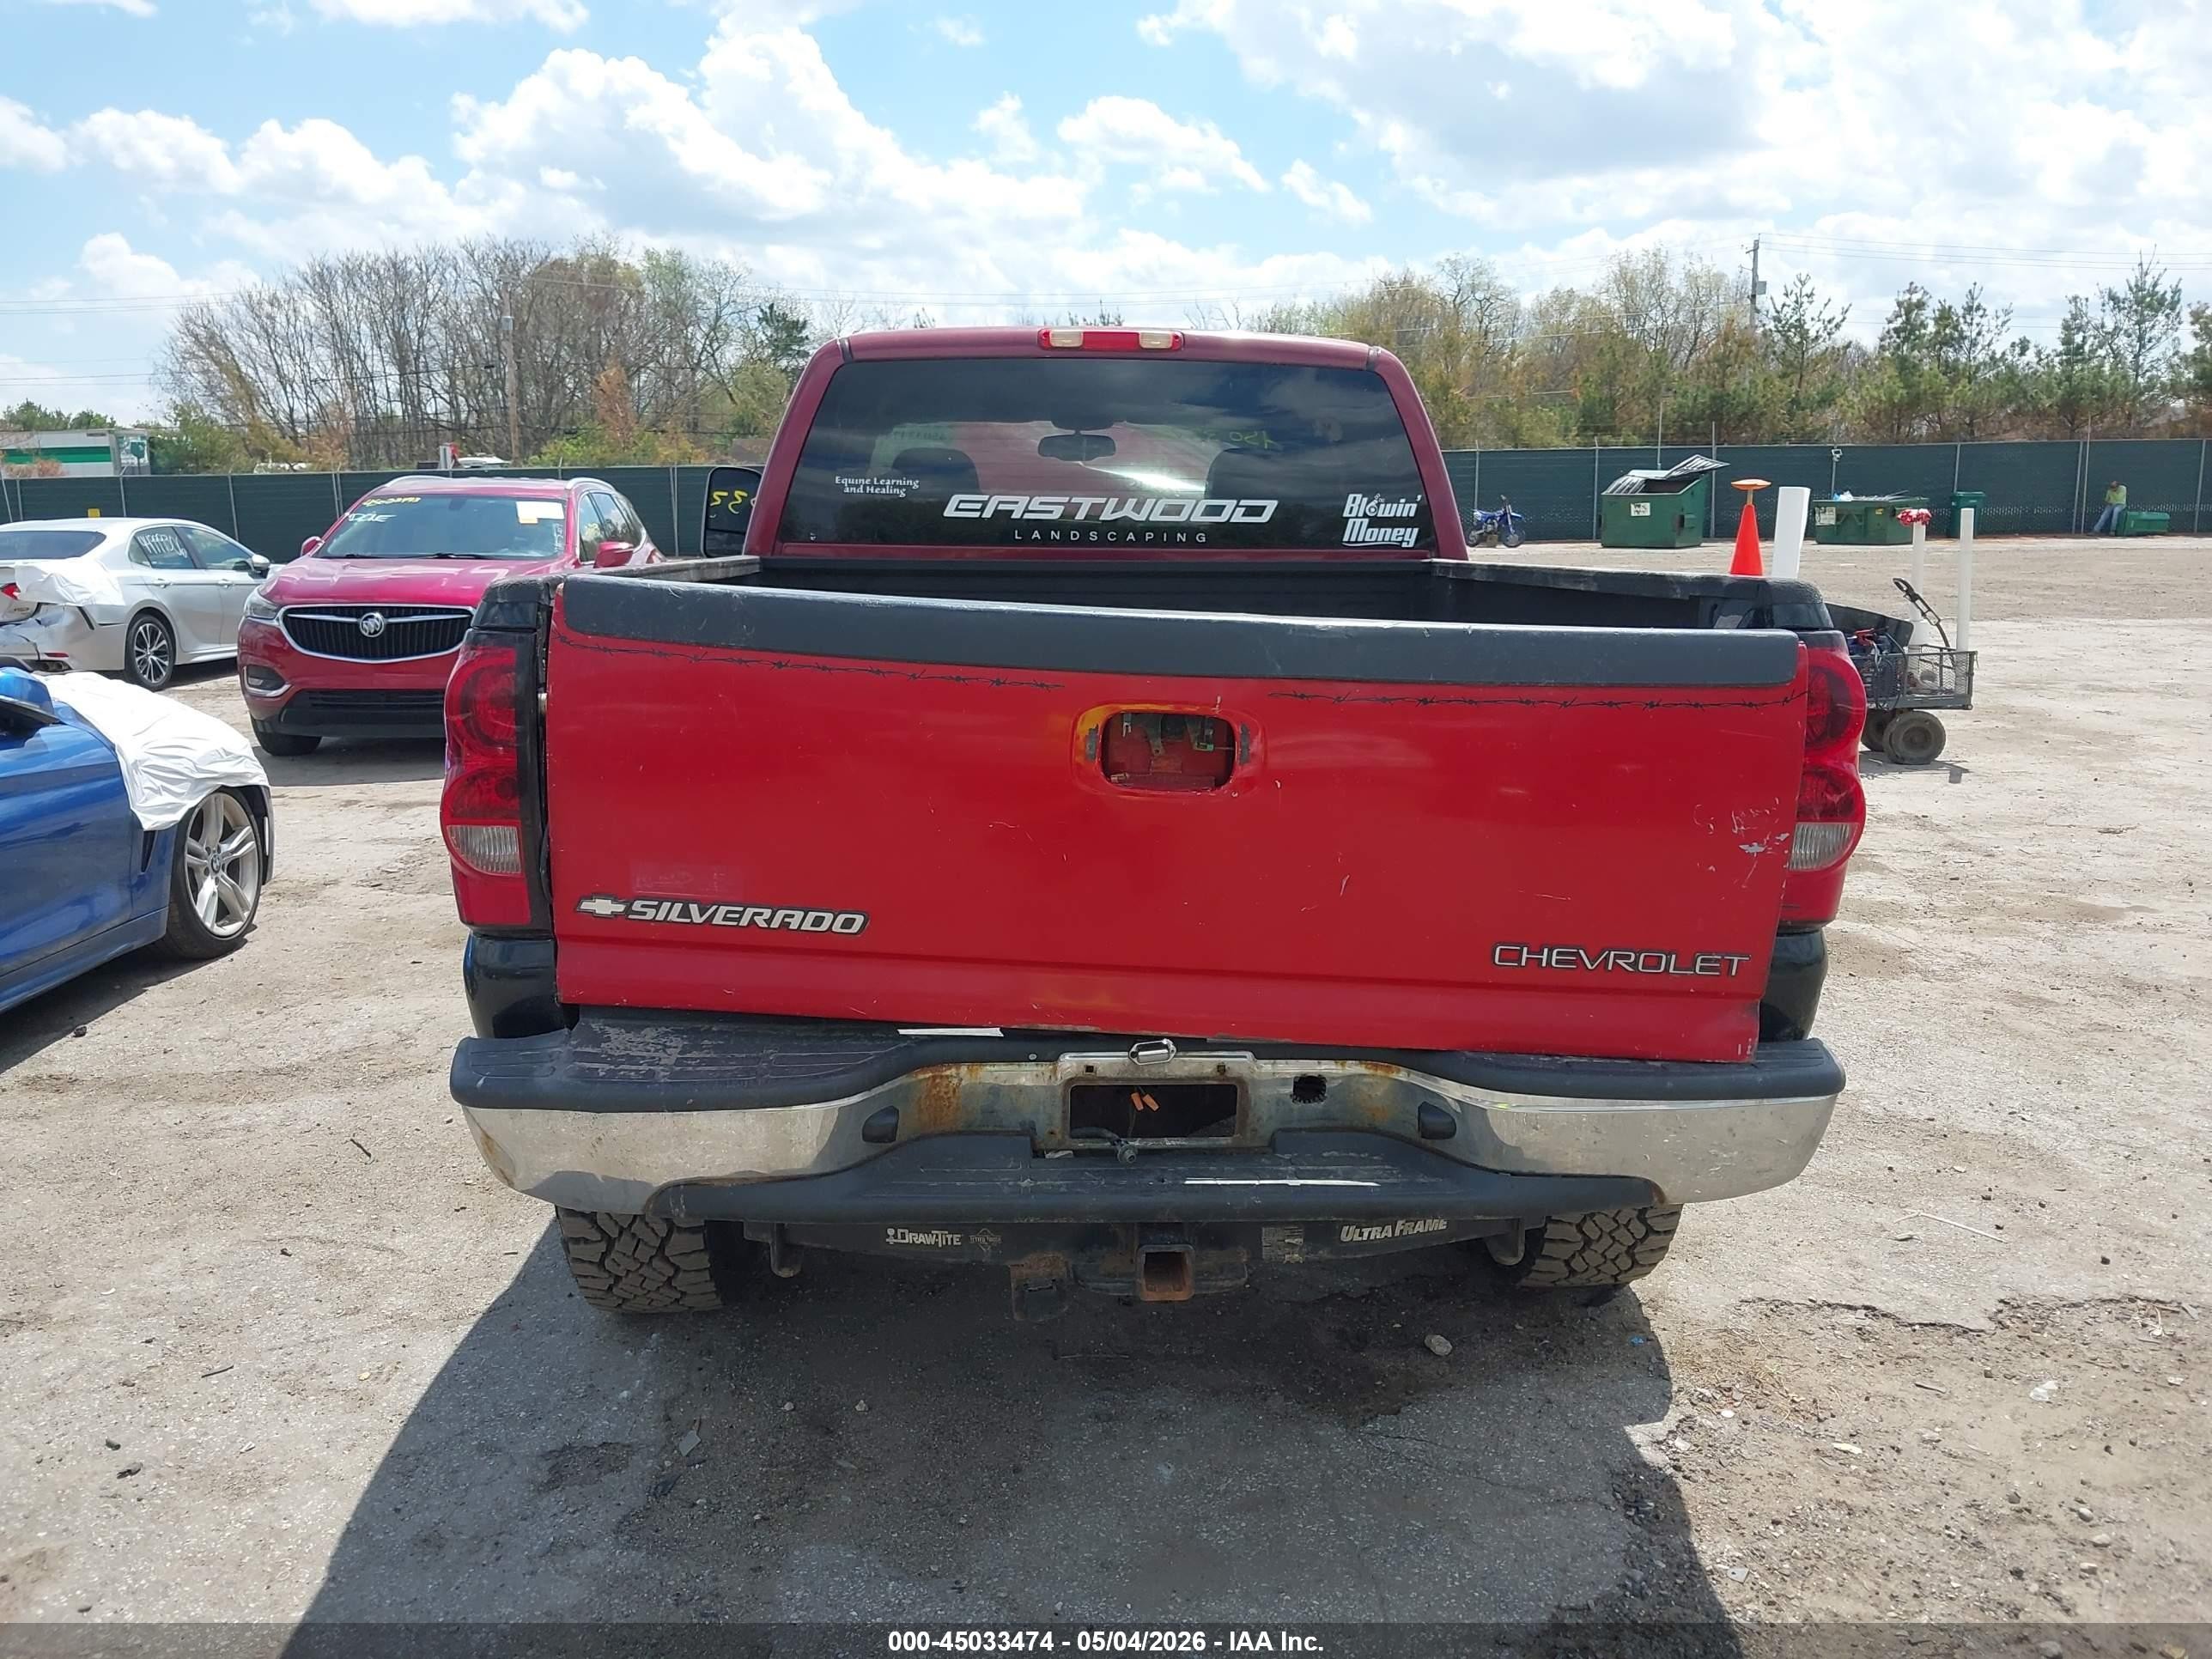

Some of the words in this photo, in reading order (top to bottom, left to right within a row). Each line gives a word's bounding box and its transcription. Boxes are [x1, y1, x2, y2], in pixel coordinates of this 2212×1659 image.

[835, 476, 871, 487] Equine
[873, 477, 920, 489] Learning
[843, 484, 864, 494] and
[866, 485, 907, 498] Healing
[943, 494, 1279, 523] EASTWOOD
[1342, 493, 1422, 517] Blowin'
[1014, 529, 1207, 544] LANDSCAPING
[1342, 518, 1419, 548] Money
[627, 899, 866, 935] SILVERADO
[1493, 945, 1751, 977] CHEVROLET
[1340, 1224, 1392, 1243] ULTRA
[1394, 1218, 1448, 1237] FRAME
